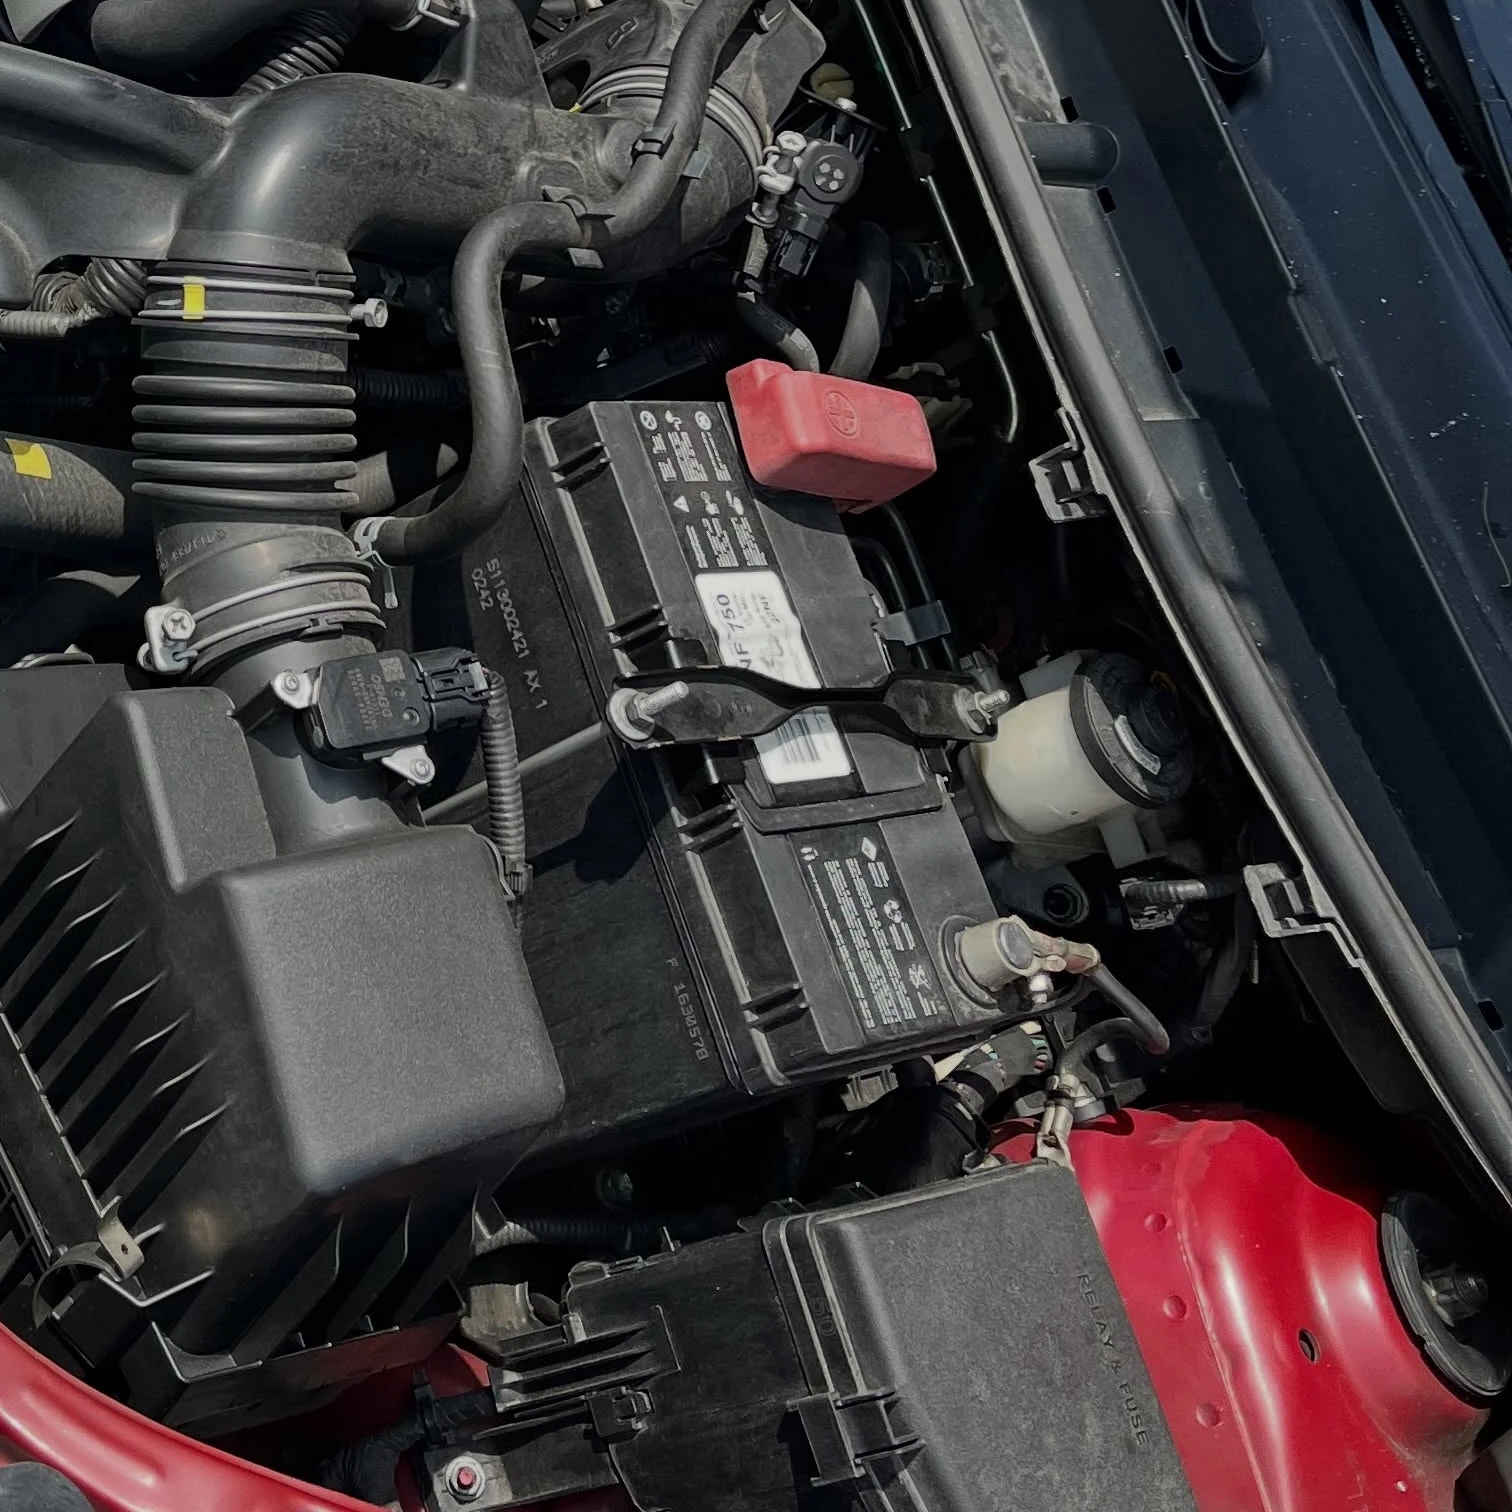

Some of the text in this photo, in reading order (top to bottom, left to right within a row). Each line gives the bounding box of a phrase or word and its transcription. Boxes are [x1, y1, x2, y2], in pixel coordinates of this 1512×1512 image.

[471, 567, 494, 611] 0242
[716, 593, 745, 633] 750
[370, 674, 394, 718] DENSO
[1077, 1274, 1116, 1349] RELAY
[1118, 1381, 1150, 1447] FUSE
